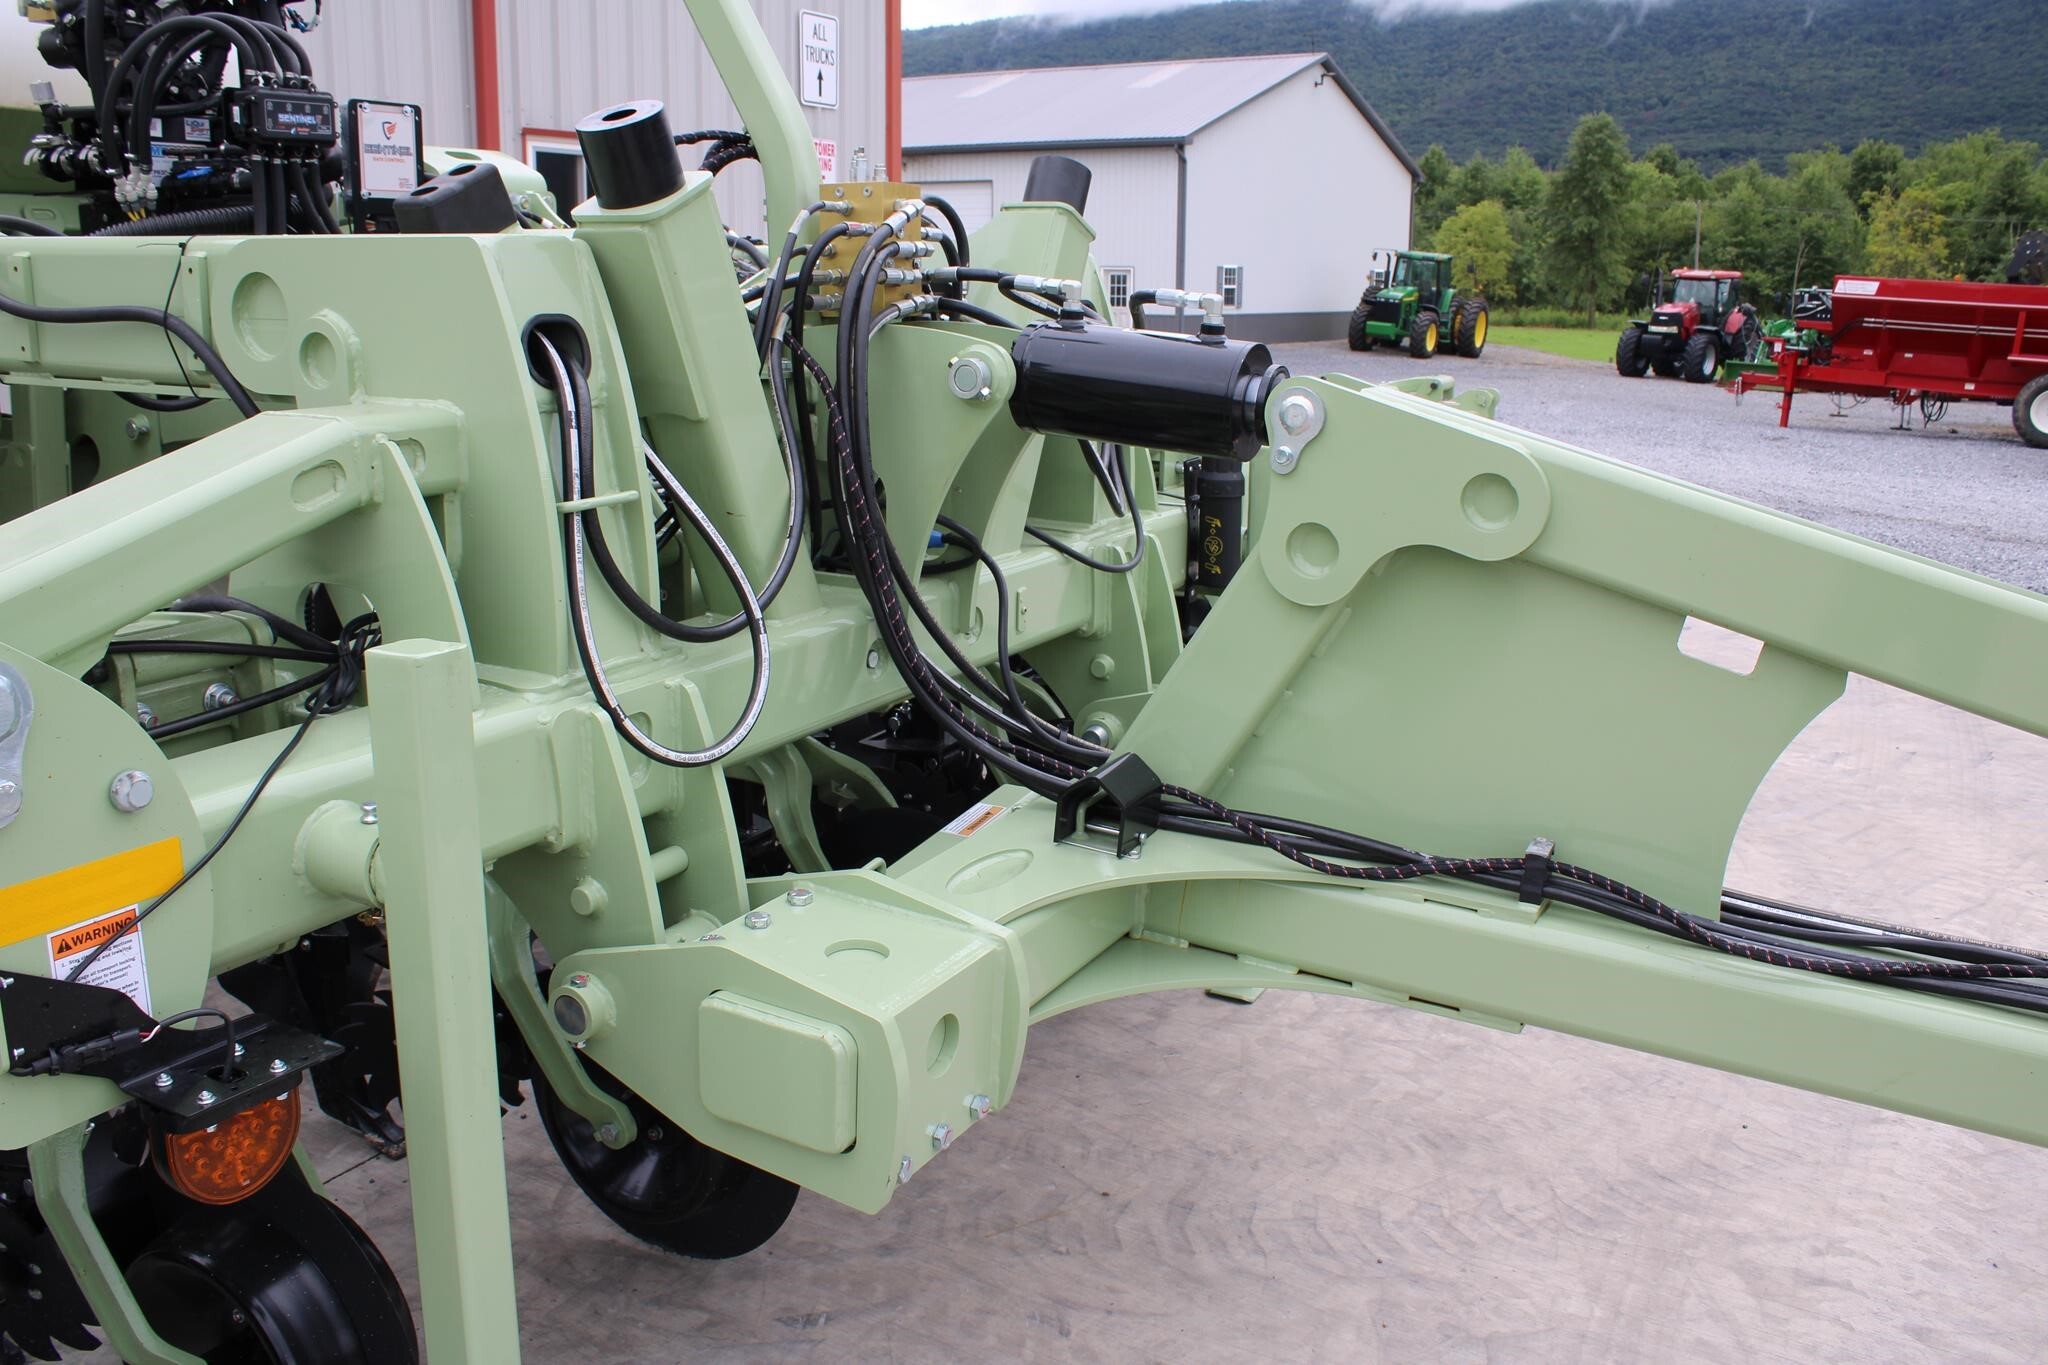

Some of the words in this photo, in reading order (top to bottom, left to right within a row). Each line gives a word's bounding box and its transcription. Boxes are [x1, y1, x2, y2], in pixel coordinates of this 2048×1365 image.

[812, 23, 827, 41] ALL
[805, 45, 835, 66] TRUCKS
[71, 917, 132, 946] WARNING
